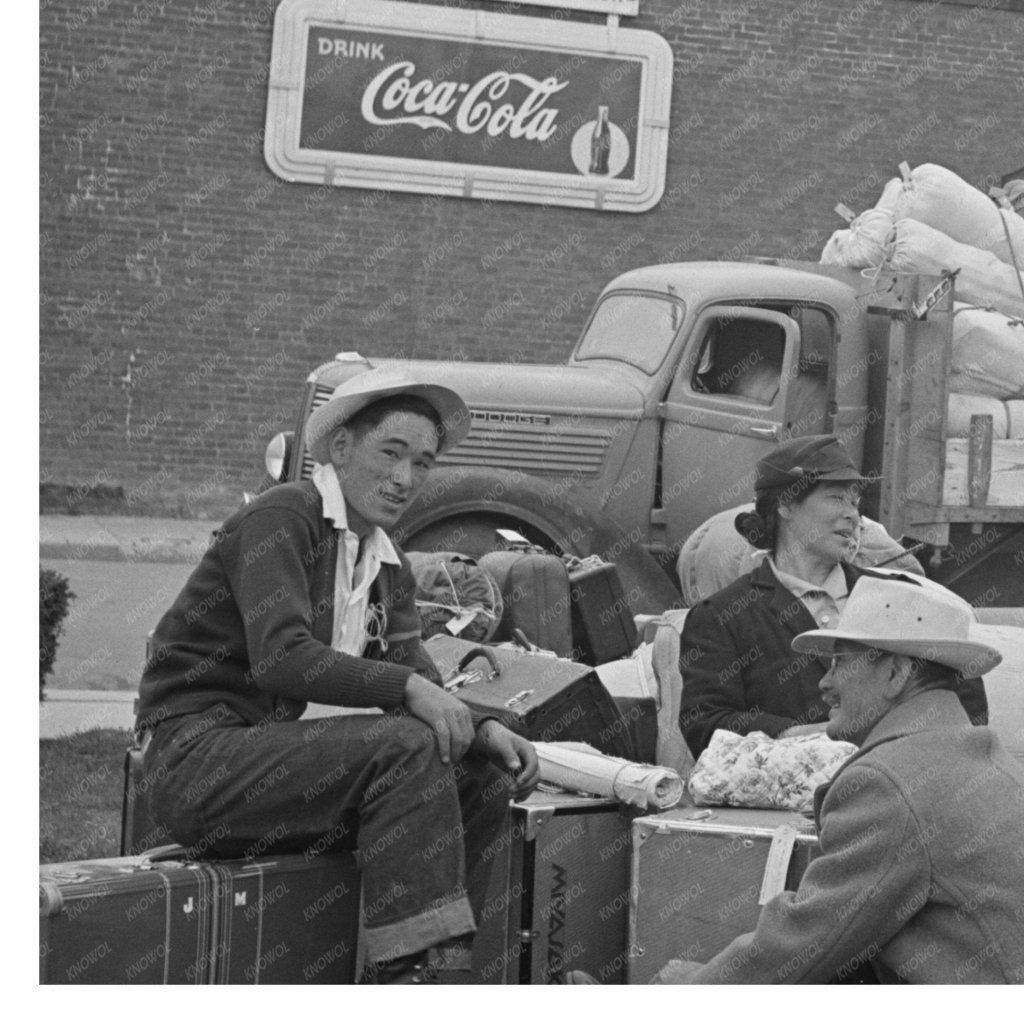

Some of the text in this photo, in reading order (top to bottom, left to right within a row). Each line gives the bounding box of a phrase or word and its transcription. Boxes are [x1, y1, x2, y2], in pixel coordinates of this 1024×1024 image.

[318, 37, 385, 61] DRINK
[361, 61, 570, 141] Coca-Cola
[183, 891, 247, 913] J M
